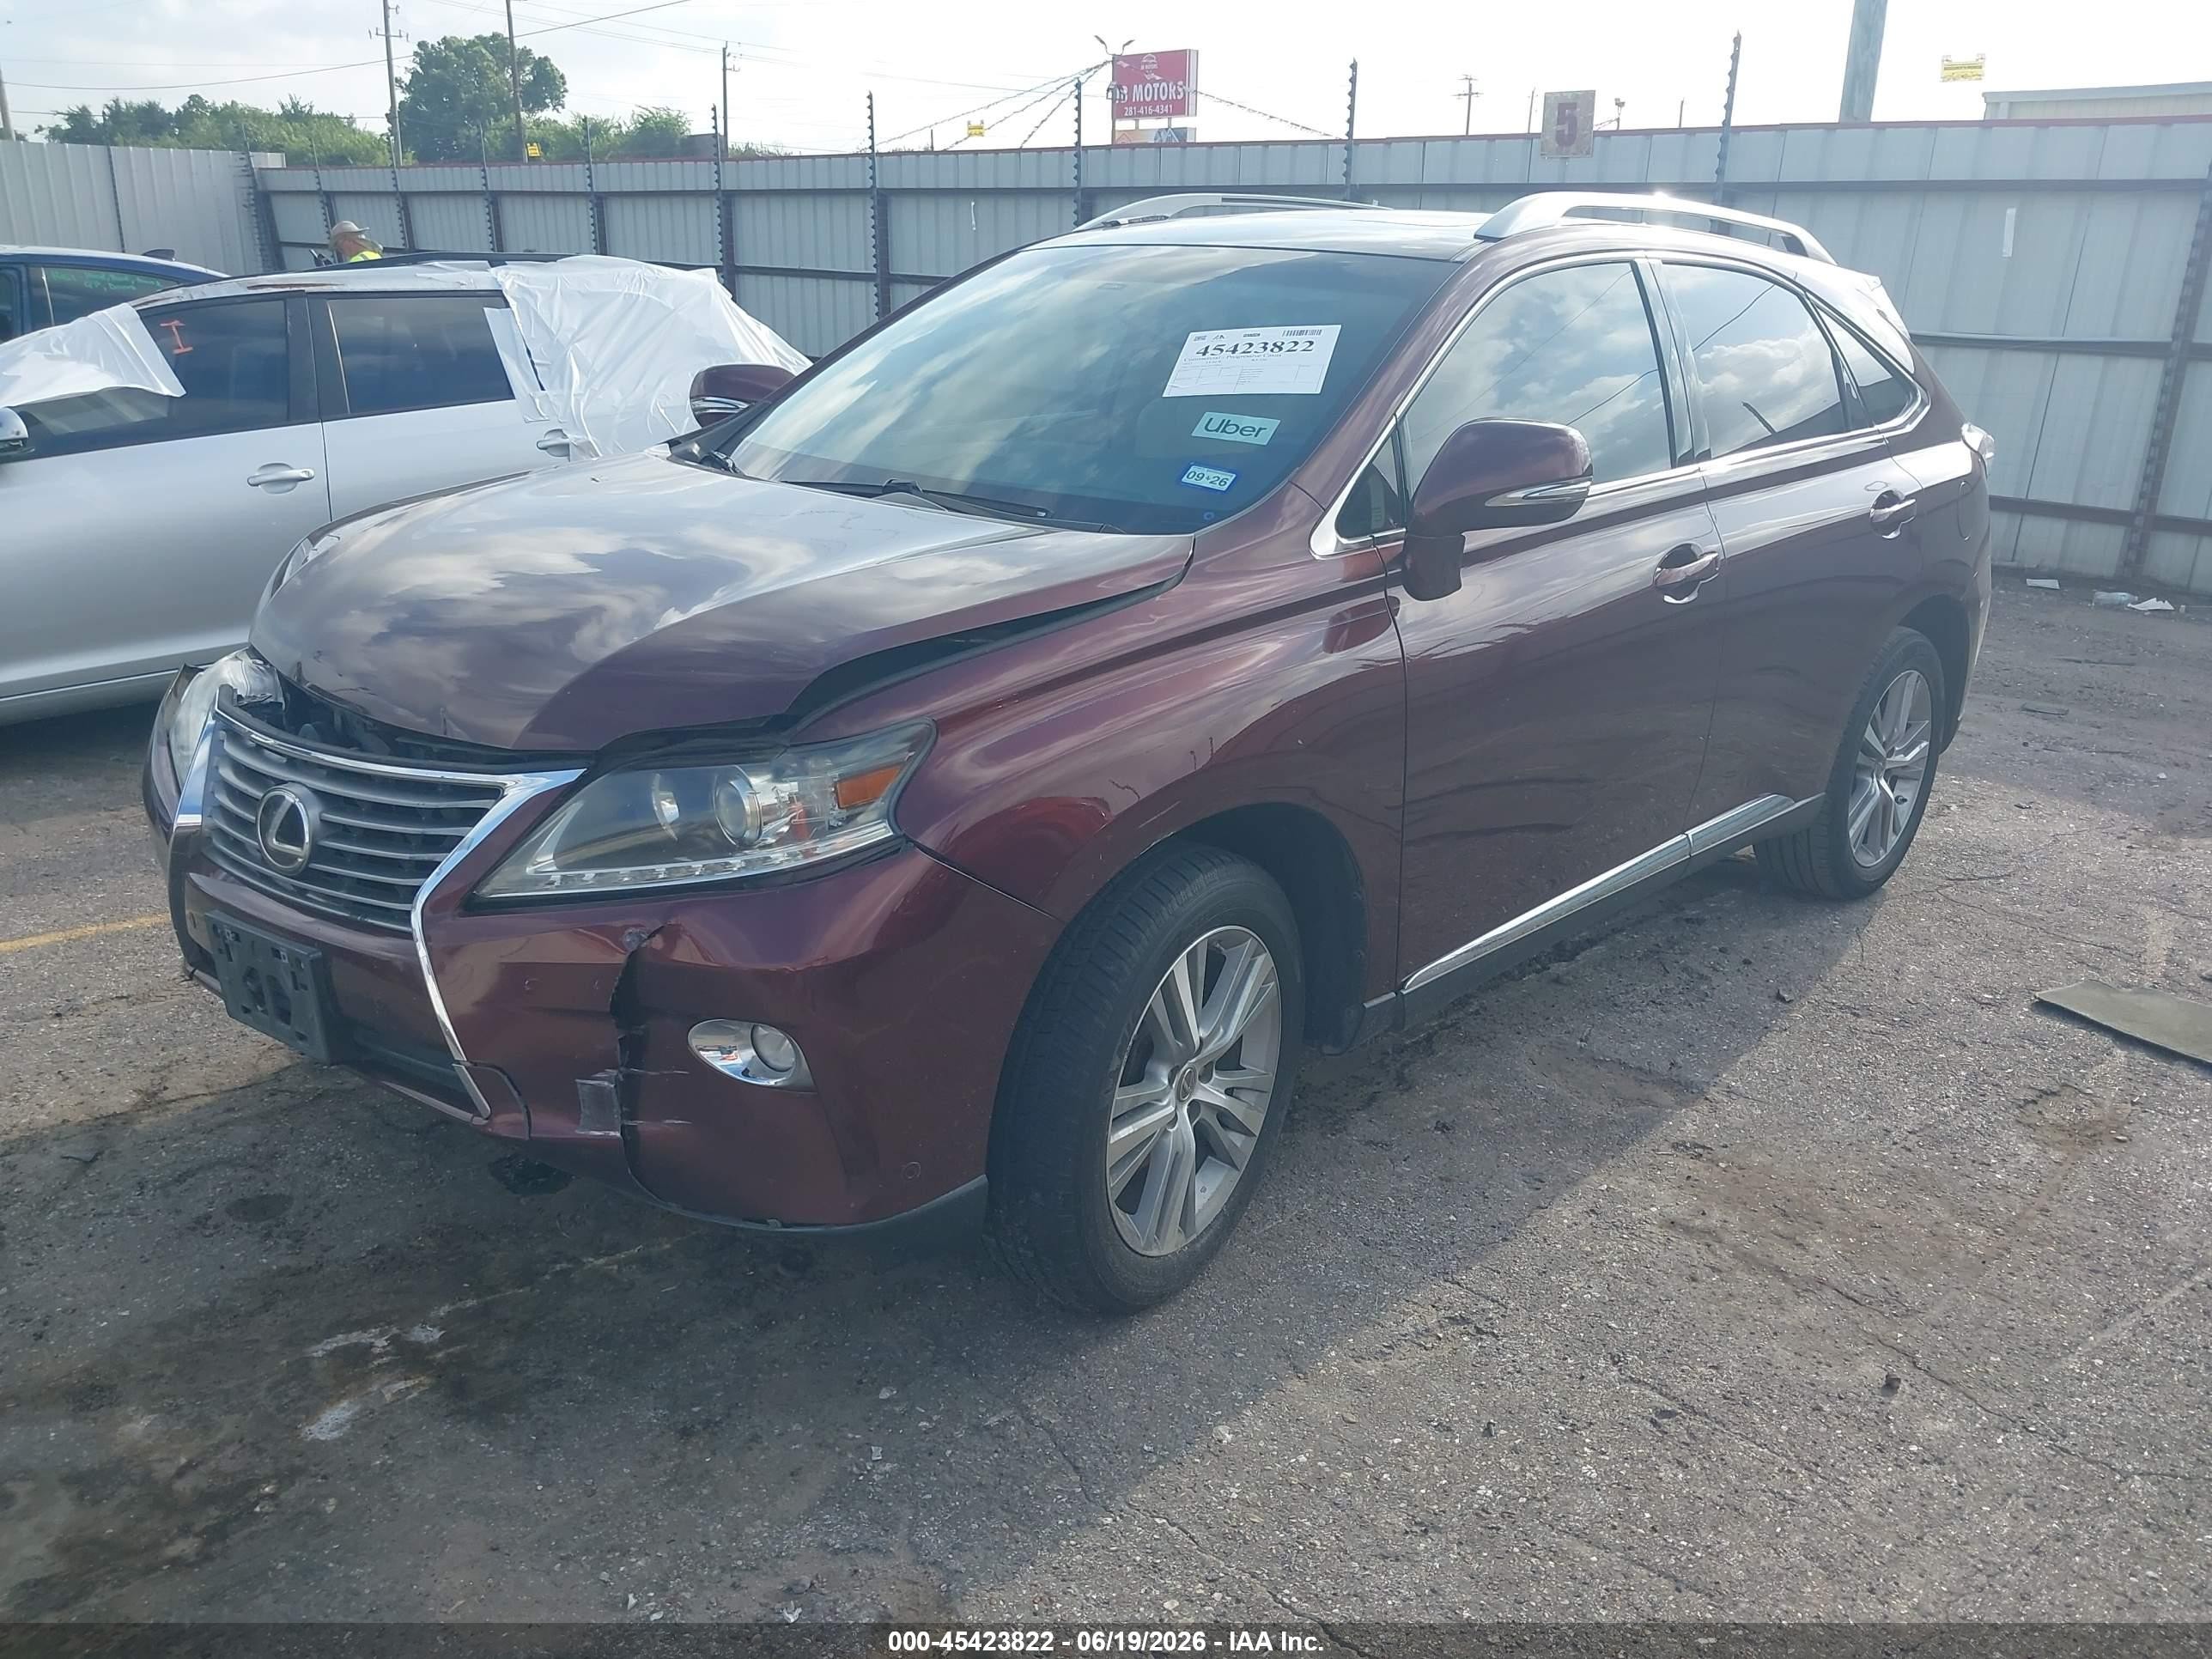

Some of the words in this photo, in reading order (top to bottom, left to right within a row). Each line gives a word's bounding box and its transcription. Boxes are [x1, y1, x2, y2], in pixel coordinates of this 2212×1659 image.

[1133, 81, 1184, 103] MOTORS
[1124, 104, 1173, 116] 281-416-4341
[1555, 102, 1578, 148] 5
[1195, 340, 1315, 357] 45423822
[1204, 417, 1267, 439] Uber
[1186, 471, 1205, 482] 09
[1209, 476, 1230, 487] 26
